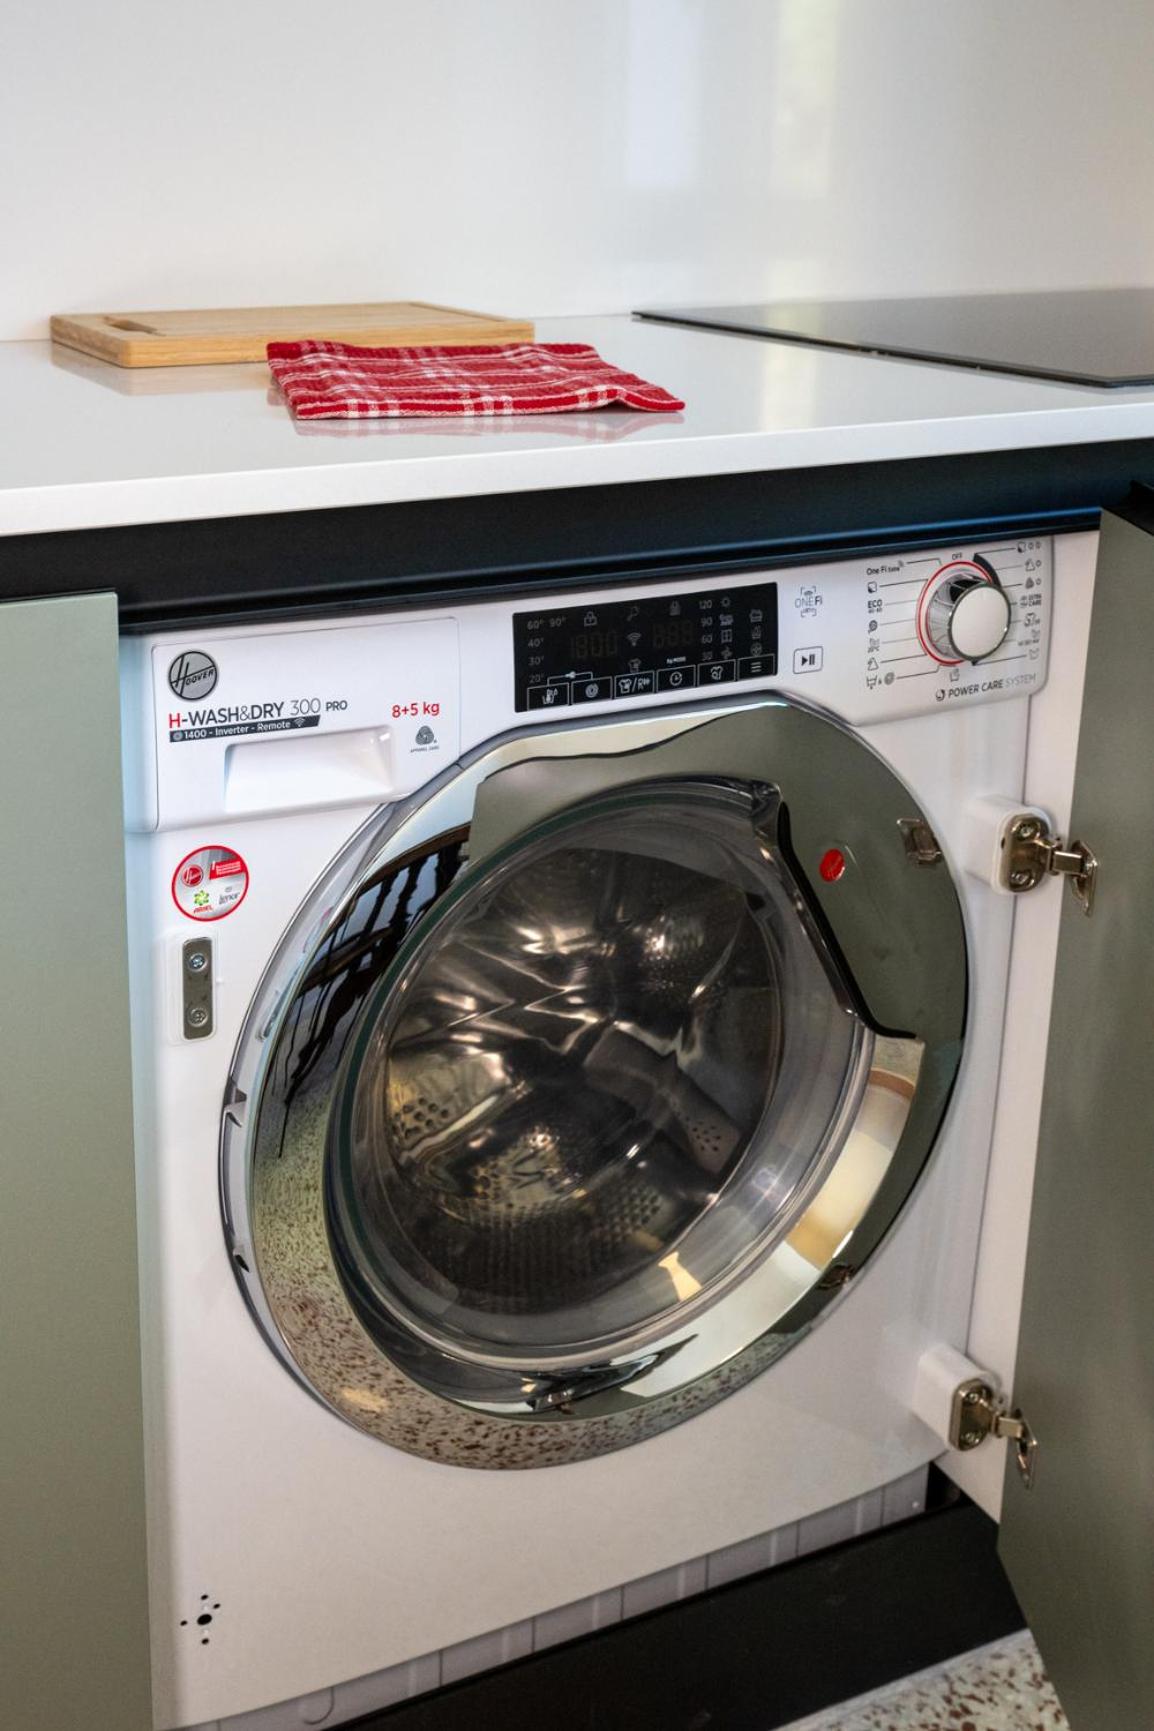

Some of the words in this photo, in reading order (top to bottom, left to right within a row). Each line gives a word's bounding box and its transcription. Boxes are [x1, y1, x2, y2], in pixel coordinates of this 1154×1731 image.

[952, 552, 963, 561] OFF
[867, 598, 883, 609] ECO
[948, 684, 980, 698] POWER
[981, 679, 1004, 692] CARE
[1005, 674, 1037, 687] SYSTEM
[168, 701, 285, 729] H-WASH&DRY
[289, 697, 321, 716] 300
[326, 700, 348, 712] PRO
[392, 702, 419, 719] 8+5
[423, 701, 440, 717] kg
[184, 729, 207, 739] 1400
[215, 725, 248, 737] Inverter
[257, 720, 291, 731] Remote
